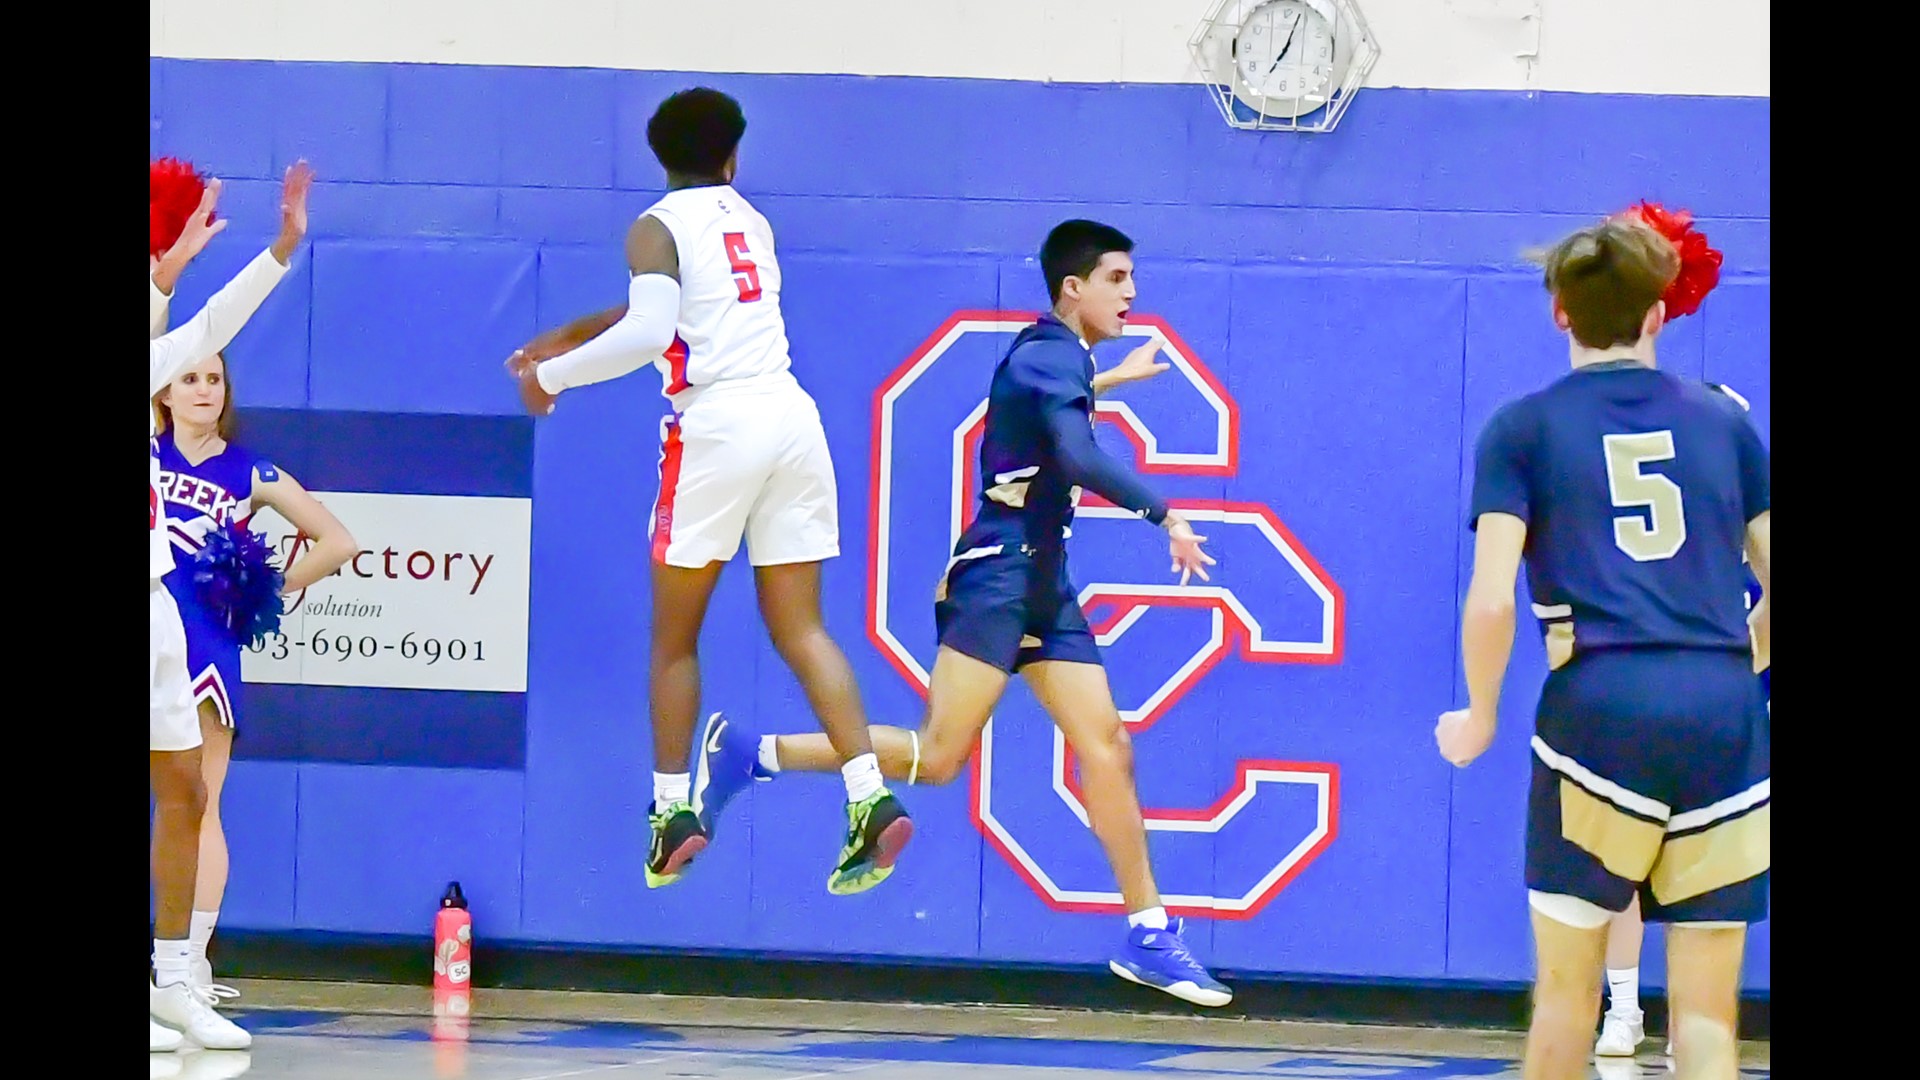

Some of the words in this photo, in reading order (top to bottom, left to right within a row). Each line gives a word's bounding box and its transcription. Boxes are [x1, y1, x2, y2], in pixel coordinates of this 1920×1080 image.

[1244, 42, 1252, 53] 9
[1249, 61, 1257, 72] 8
[1313, 65, 1320, 76] 4
[1279, 80, 1287, 91] 6
[723, 232, 762, 303] 5
[1603, 430, 1687, 562] 5
[304, 595, 383, 618] solution
